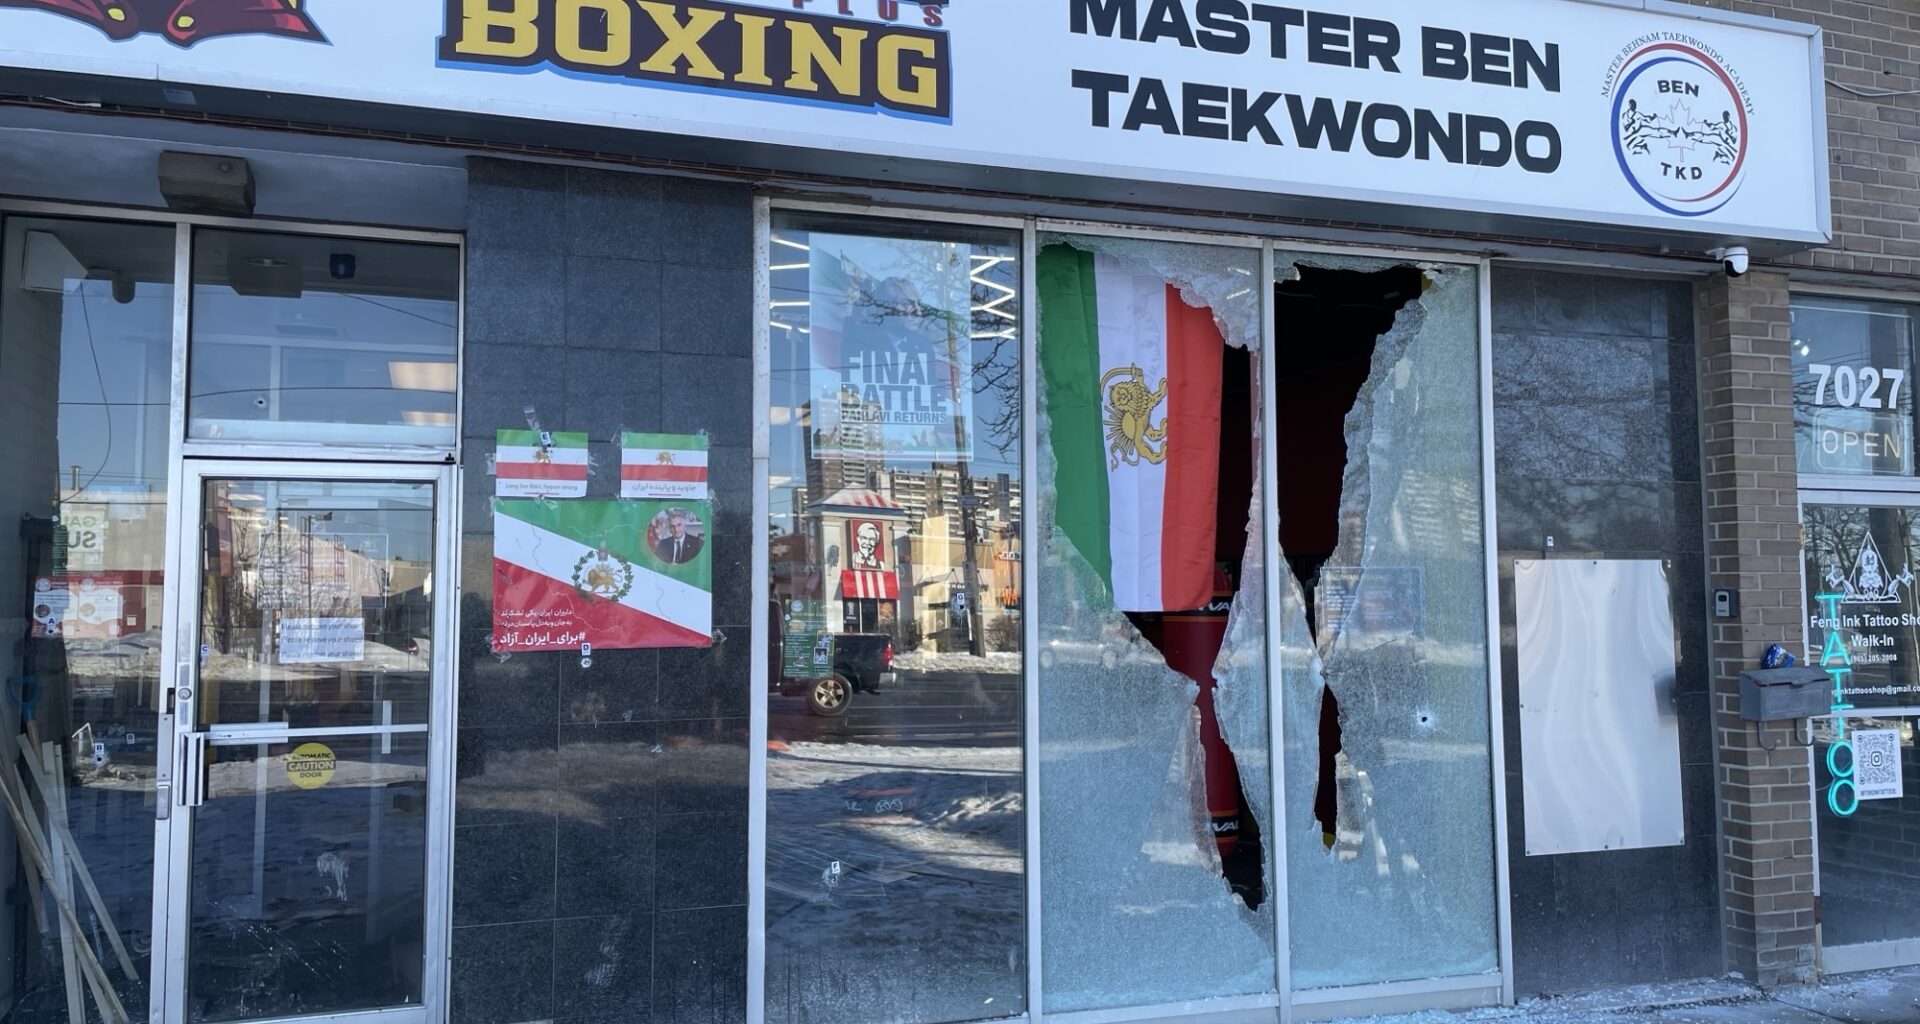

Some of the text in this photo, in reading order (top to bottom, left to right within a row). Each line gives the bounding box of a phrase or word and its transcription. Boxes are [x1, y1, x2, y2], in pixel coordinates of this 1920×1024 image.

[455, 0, 937, 109] BOXING
[1069, 0, 1561, 93] MASTER BEN
[1601, 31, 1756, 116] MASTER BEHNAM TAEKWONDO ACADEMY
[1657, 80, 1700, 98] BEN
[1071, 68, 1562, 175] TAEKWONDO
[1660, 161, 1703, 180] TKD
[841, 349, 938, 385] FINAL
[841, 384, 947, 412] BATTLE
[1808, 363, 1904, 409] 7027
[894, 411, 946, 424] RETURNS
[1822, 429, 1901, 459] OPEN
[1810, 615, 1840, 630] Feng
[1842, 614, 1860, 627] Ink
[1862, 613, 1899, 627] Tattoo
[1851, 634, 1894, 647] Walk-In
[1815, 593, 1859, 816] TATTOO
[289, 760, 334, 771] CAUTION
